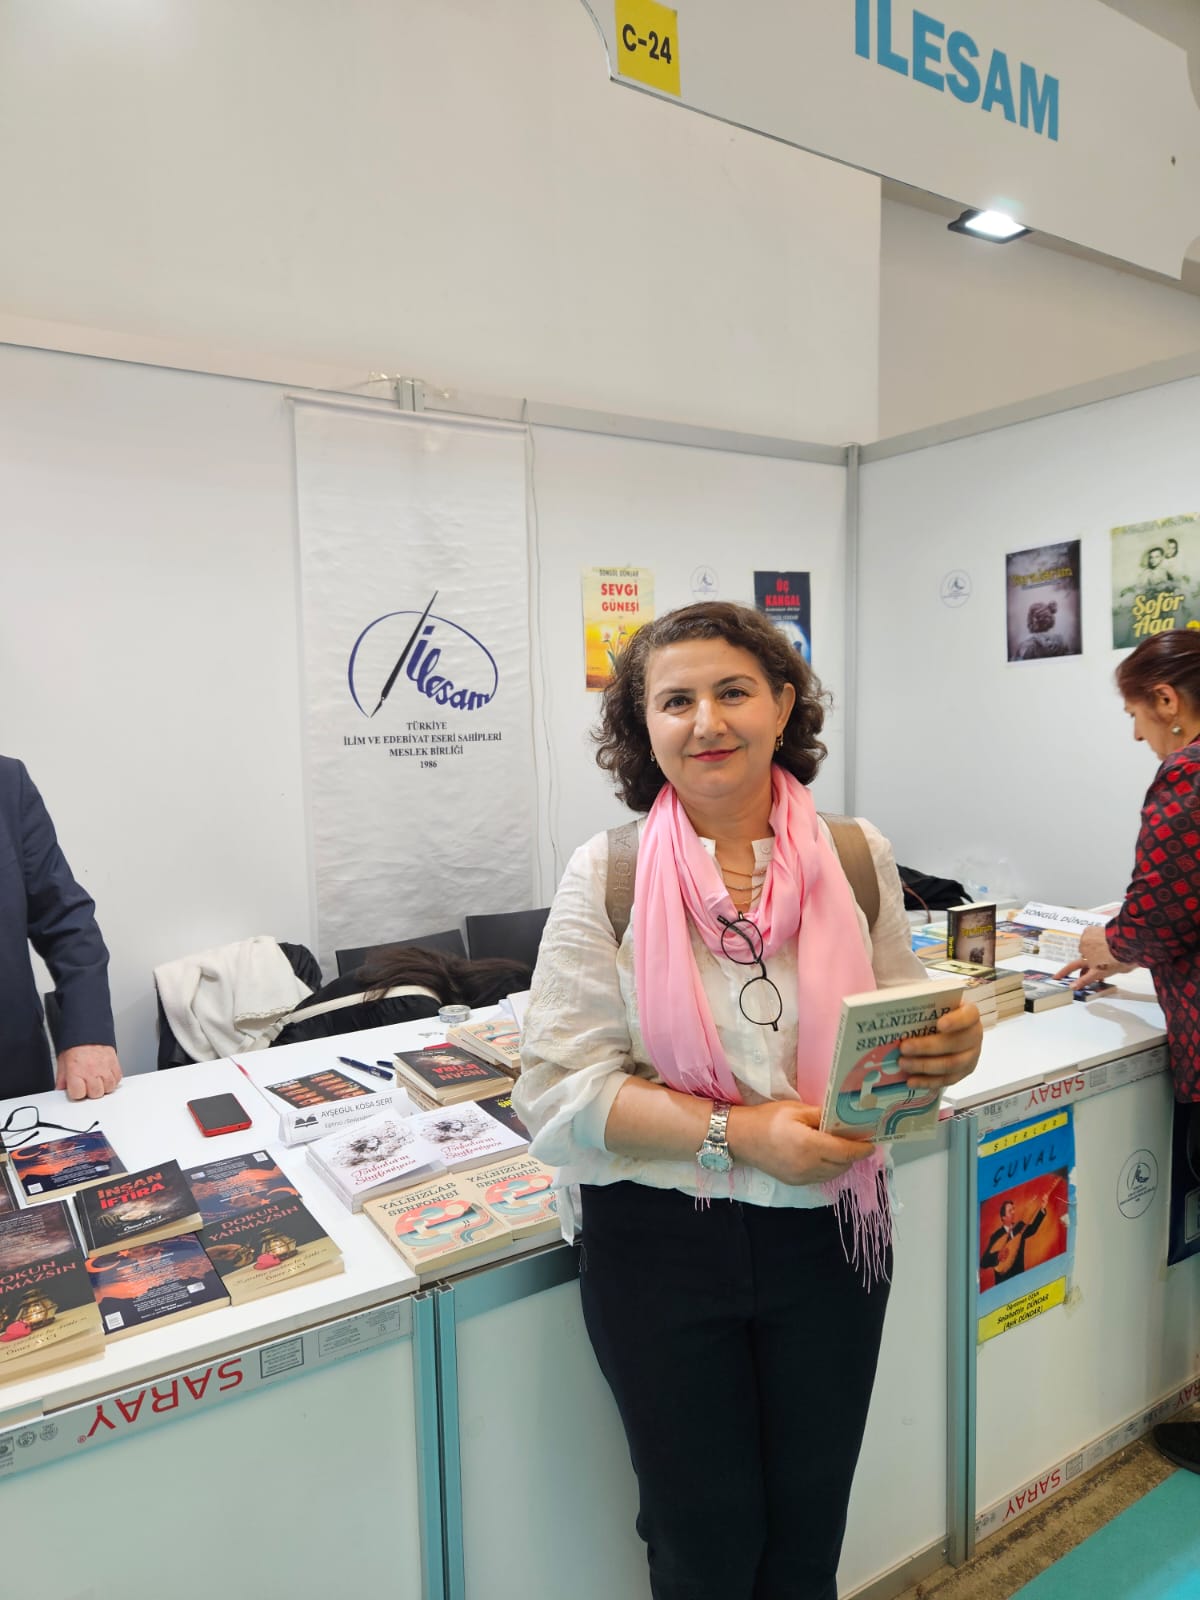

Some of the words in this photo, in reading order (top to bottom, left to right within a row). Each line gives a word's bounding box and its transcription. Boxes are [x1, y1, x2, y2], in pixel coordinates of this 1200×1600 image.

[622, 23, 672, 64] C-24
[601, 580, 638, 597] SEVGİ
[602, 599, 640, 615] GÜNEŞİ
[1132, 592, 1184, 620] Şoför
[406, 720, 448, 731] TÜRKİYE
[343, 735, 366, 746] İLİM
[368, 736, 381, 745] VE
[383, 733, 430, 745] EDEBİYAT
[431, 733, 456, 743] ESERİ
[457, 731, 502, 742] SAHİPLERİ
[389, 748, 428, 757] MESLEK
[430, 744, 464, 756] BİRLİĞİ
[419, 760, 438, 769] 1986
[321, 1103, 354, 1118] AYŞEGÜL
[378, 1182, 457, 1211] YALNIZLAR
[208, 1205, 299, 1241] YANMAZSIN
[221, 1205, 280, 1229] DOKUN
[87, 1357, 244, 1437] SARAY
[1004, 1468, 1061, 1520] SARAY
